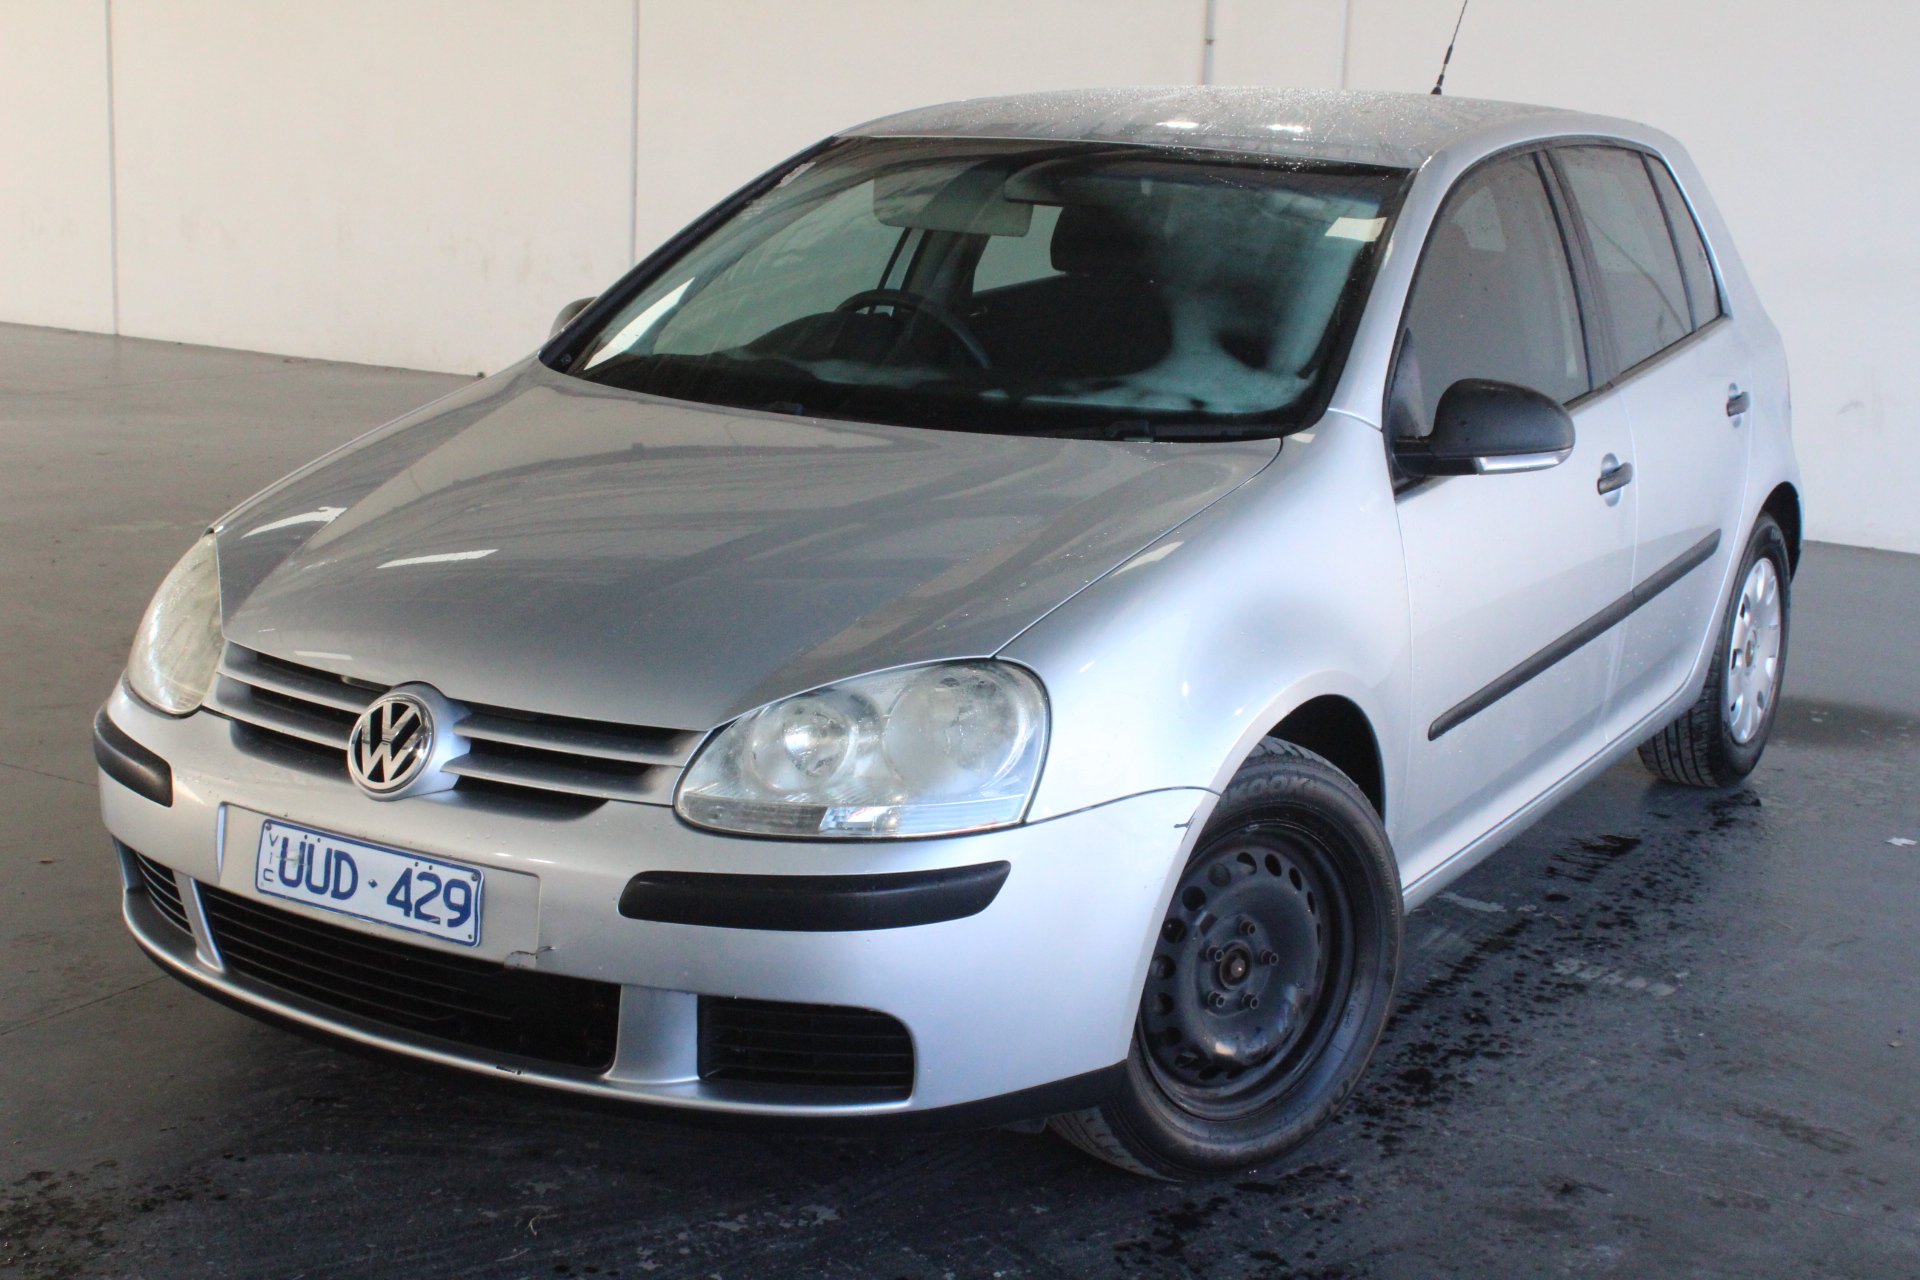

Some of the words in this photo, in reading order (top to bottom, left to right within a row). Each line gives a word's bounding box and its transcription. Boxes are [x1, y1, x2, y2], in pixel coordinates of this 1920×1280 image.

[355, 699, 423, 788] VW
[1222, 774, 1310, 804] KOOK
[262, 833, 279, 883] VIC
[278, 837, 359, 900] UUD
[386, 867, 472, 928] 429
